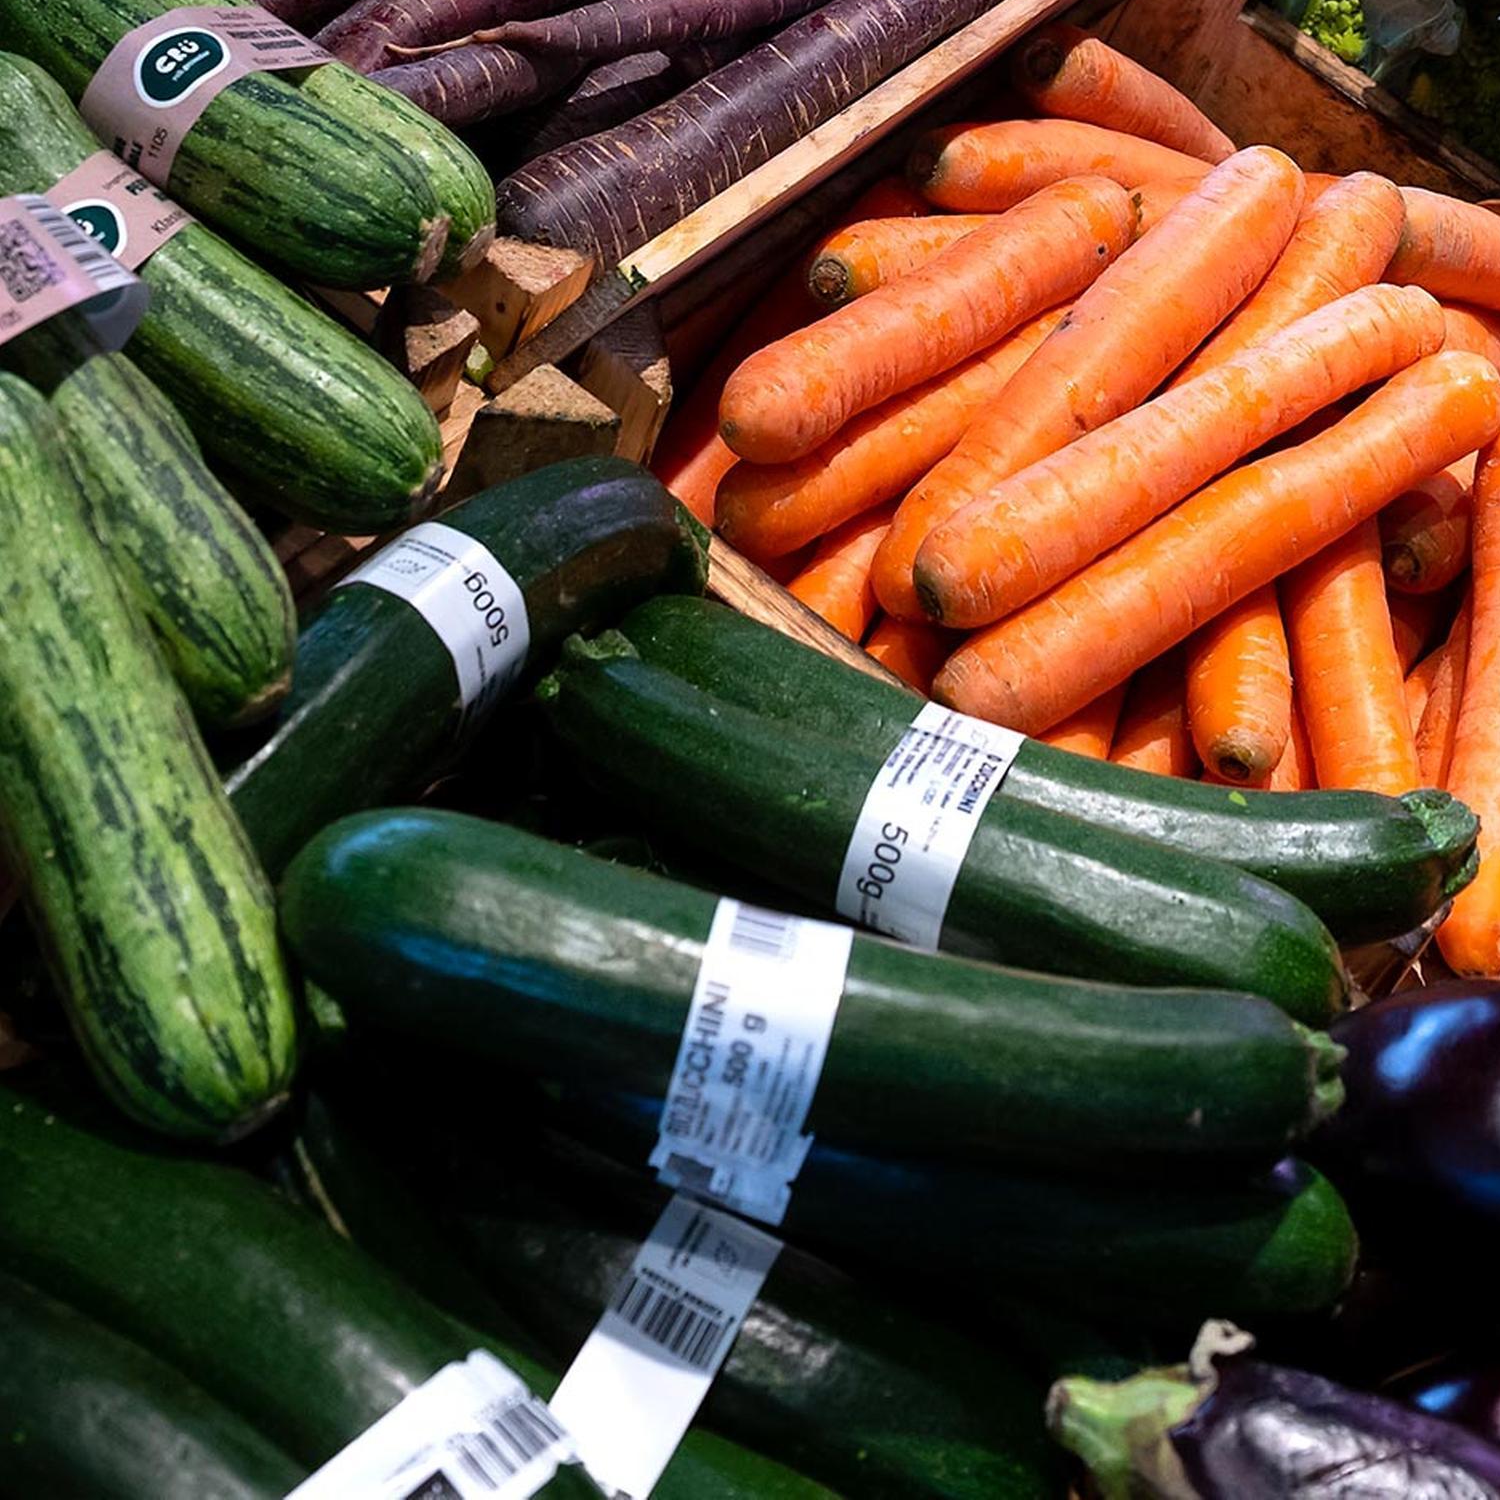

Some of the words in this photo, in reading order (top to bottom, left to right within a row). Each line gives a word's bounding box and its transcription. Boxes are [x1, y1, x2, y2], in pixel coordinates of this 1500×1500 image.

[155, 39, 200, 74] CRÜ
[463, 571, 509, 648] 500g
[956, 761, 999, 816] ZUCCHINI
[856, 822, 909, 900] 500g
[722, 1040, 754, 1089] 500
[743, 1013, 768, 1034] g
